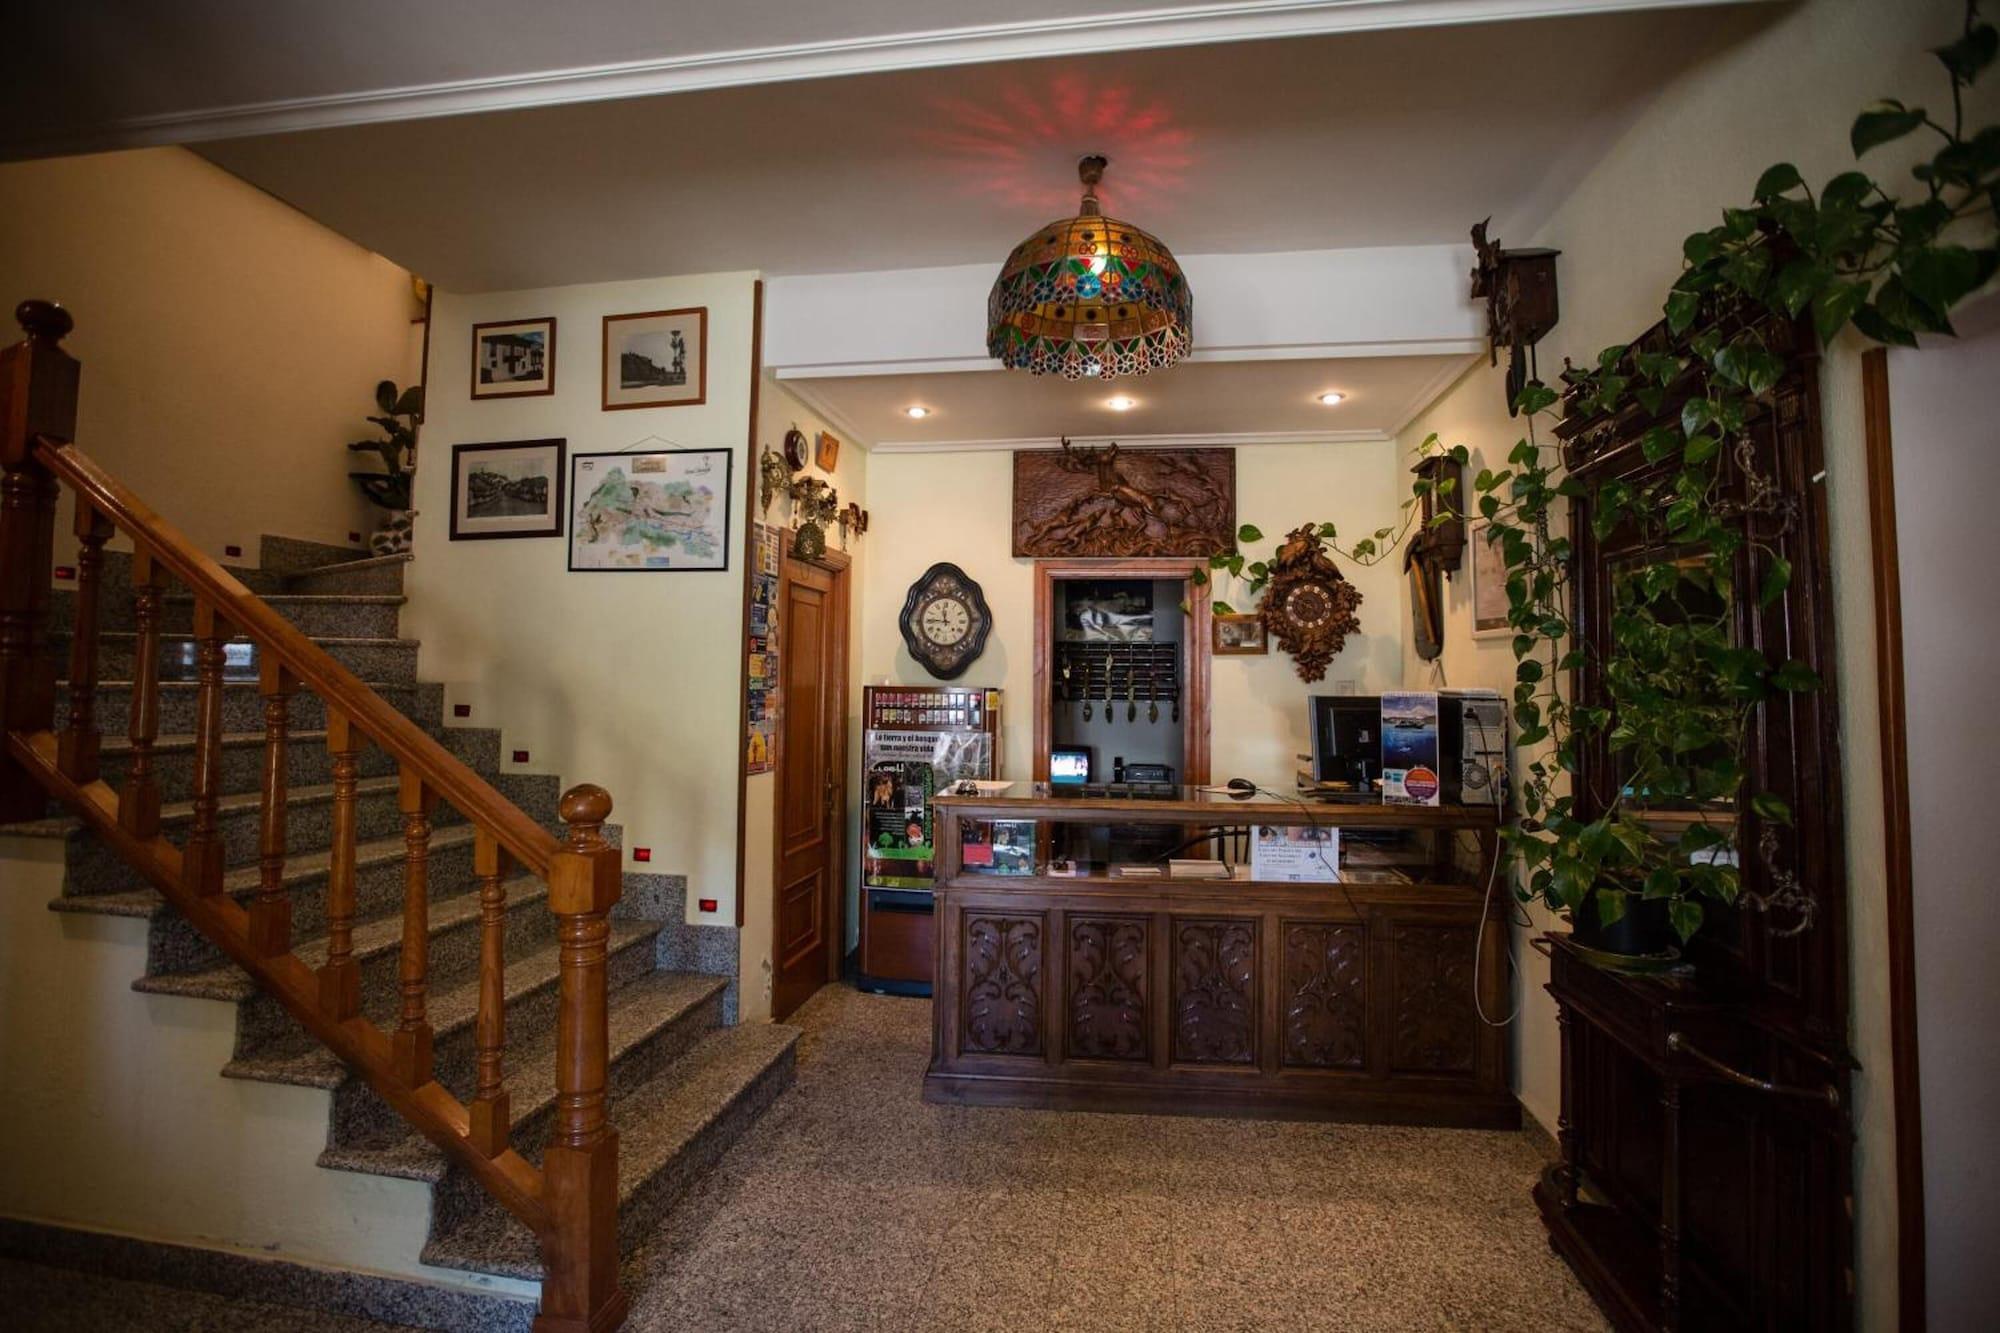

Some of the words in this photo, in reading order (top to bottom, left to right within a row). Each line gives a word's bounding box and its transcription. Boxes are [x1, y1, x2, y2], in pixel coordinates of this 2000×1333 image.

[875, 732, 882, 741] La
[884, 733, 902, 742] tierra
[908, 734, 914, 742] el
[894, 744, 919, 752] nuestra
[920, 744, 934, 753] vida
